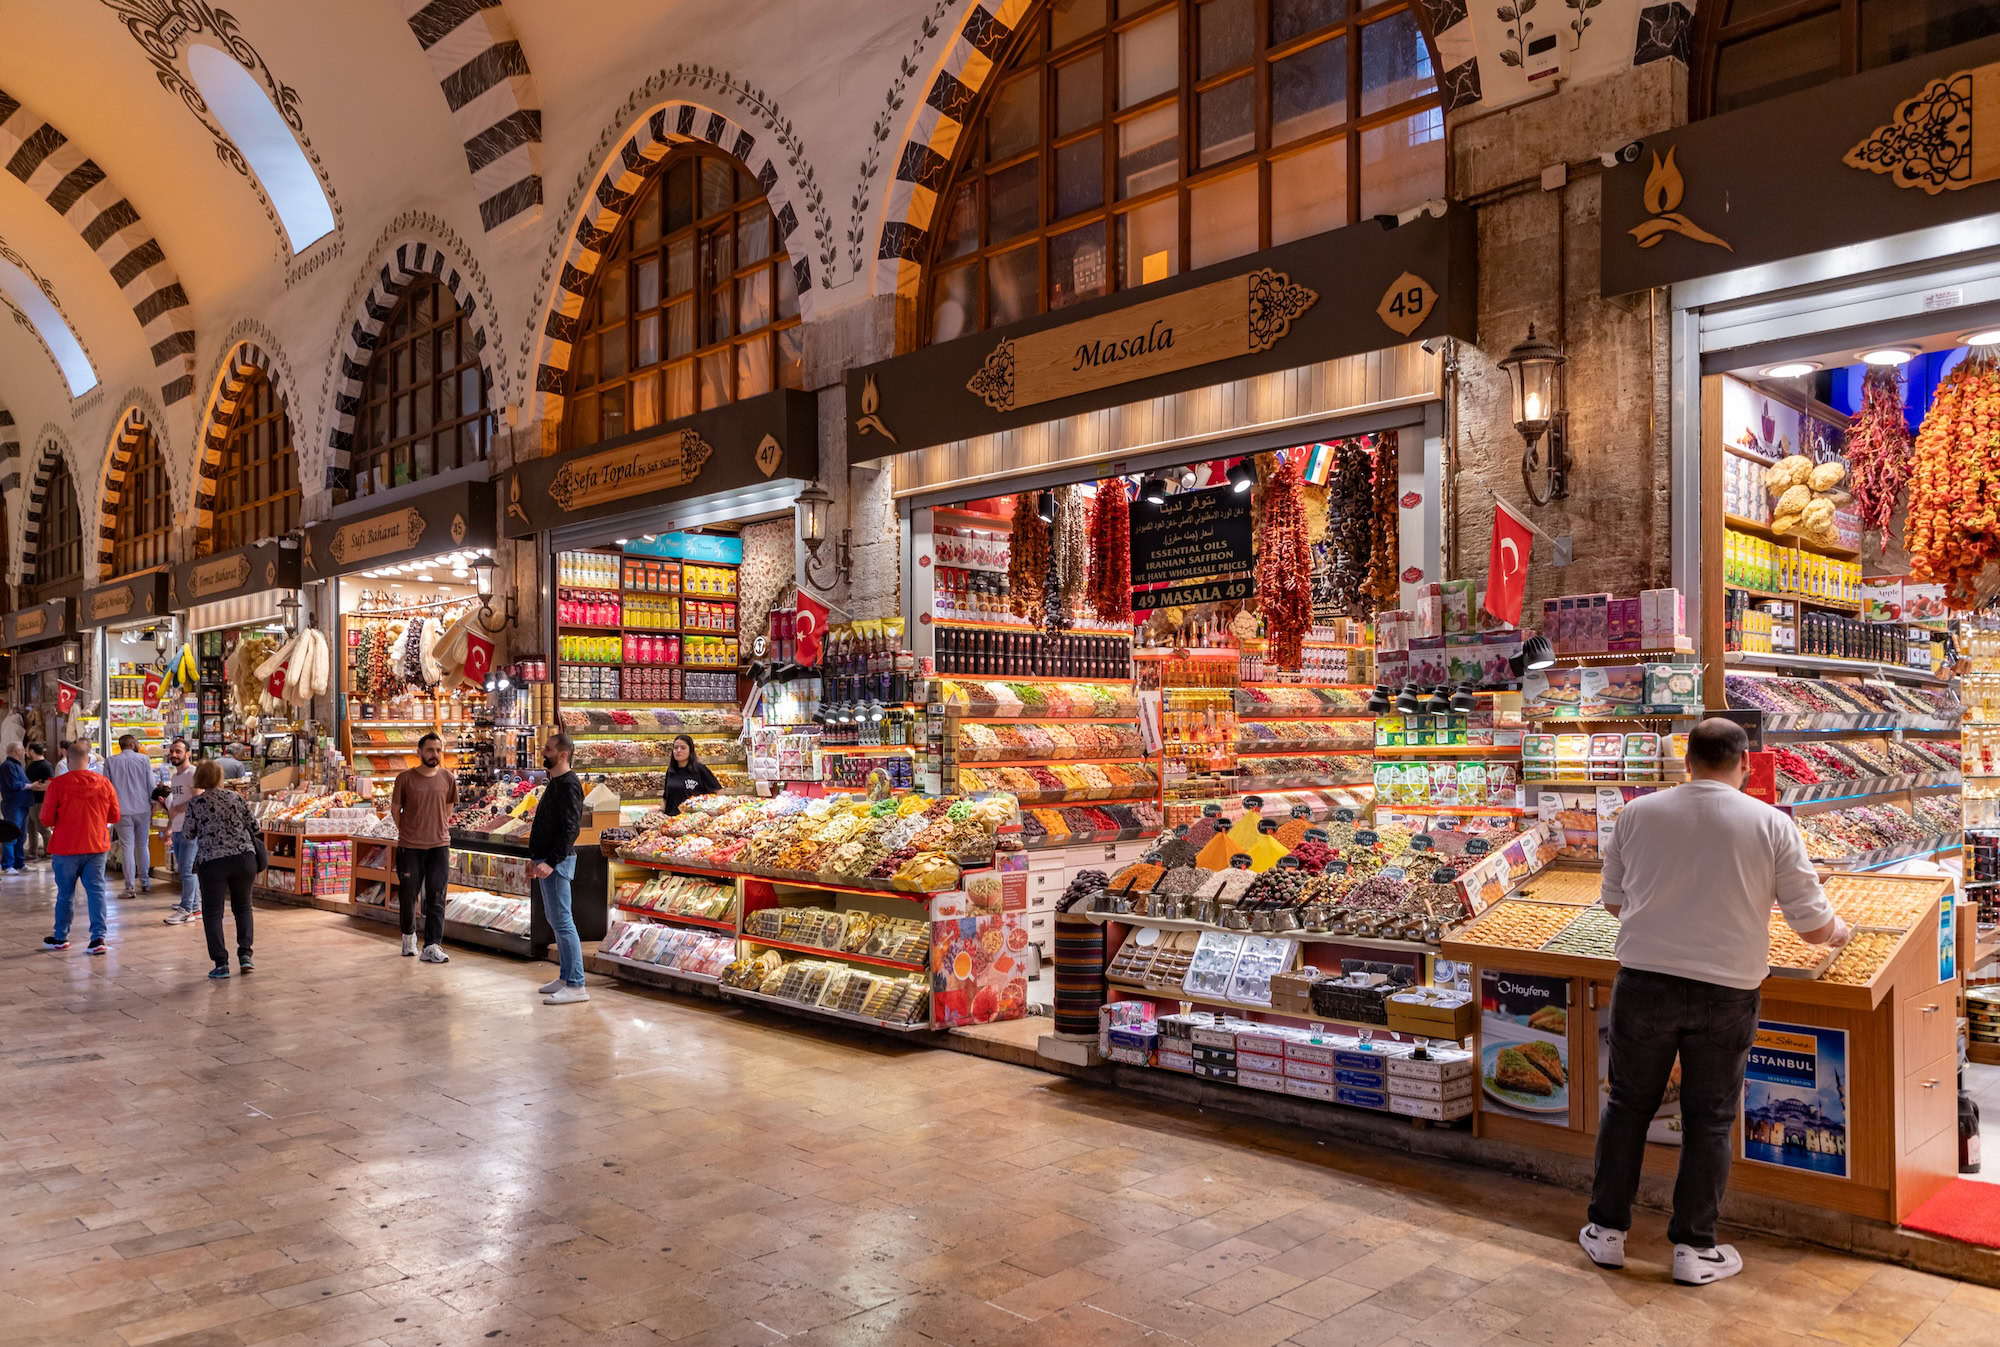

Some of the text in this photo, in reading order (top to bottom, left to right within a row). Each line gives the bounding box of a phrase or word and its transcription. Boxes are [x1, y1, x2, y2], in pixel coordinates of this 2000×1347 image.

[1389, 288, 1423, 317] 49
[1072, 320, 1175, 372] Masala
[761, 445, 775, 465] 47
[572, 472, 597, 495] Sefa
[601, 454, 639, 488] Topal
[351, 523, 400, 552] Sufi Baharat
[453, 522, 462, 536] 45
[1151, 540, 1228, 559] ESSENTIAL OILS
[1146, 551, 1234, 570] IRANIAN SAFFRON
[215, 567, 236, 583] Baharat
[1135, 560, 1247, 582] WE HAVE WHOLESALE PRICES
[1138, 583, 1246, 608] 49 MASALA 49
[1877, 589, 1899, 597] Apple
[1511, 983, 1550, 997] Hayfene
[1747, 1054, 1814, 1072] ISTANBUL
[1767, 1076, 1812, 1087] SEVENTH EDITION
